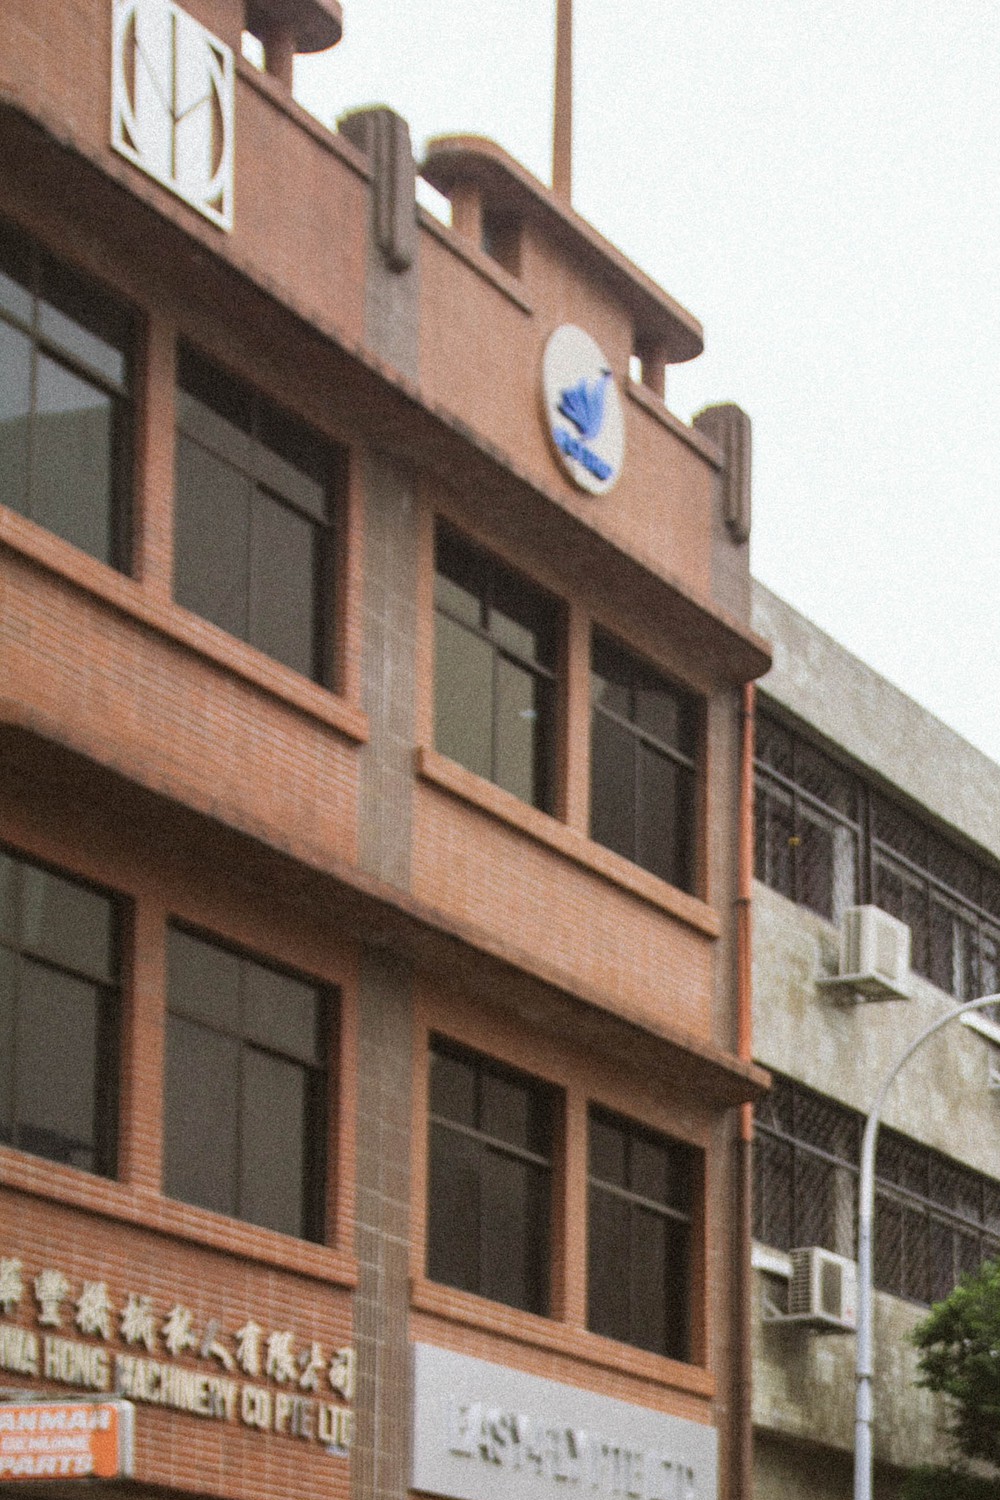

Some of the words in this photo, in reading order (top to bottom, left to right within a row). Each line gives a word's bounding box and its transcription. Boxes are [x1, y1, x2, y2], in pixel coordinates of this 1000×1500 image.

[45, 1336, 109, 1389] HONG
[116, 1354, 236, 1420] MACHINERY
[242, 1385, 271, 1428] CO
